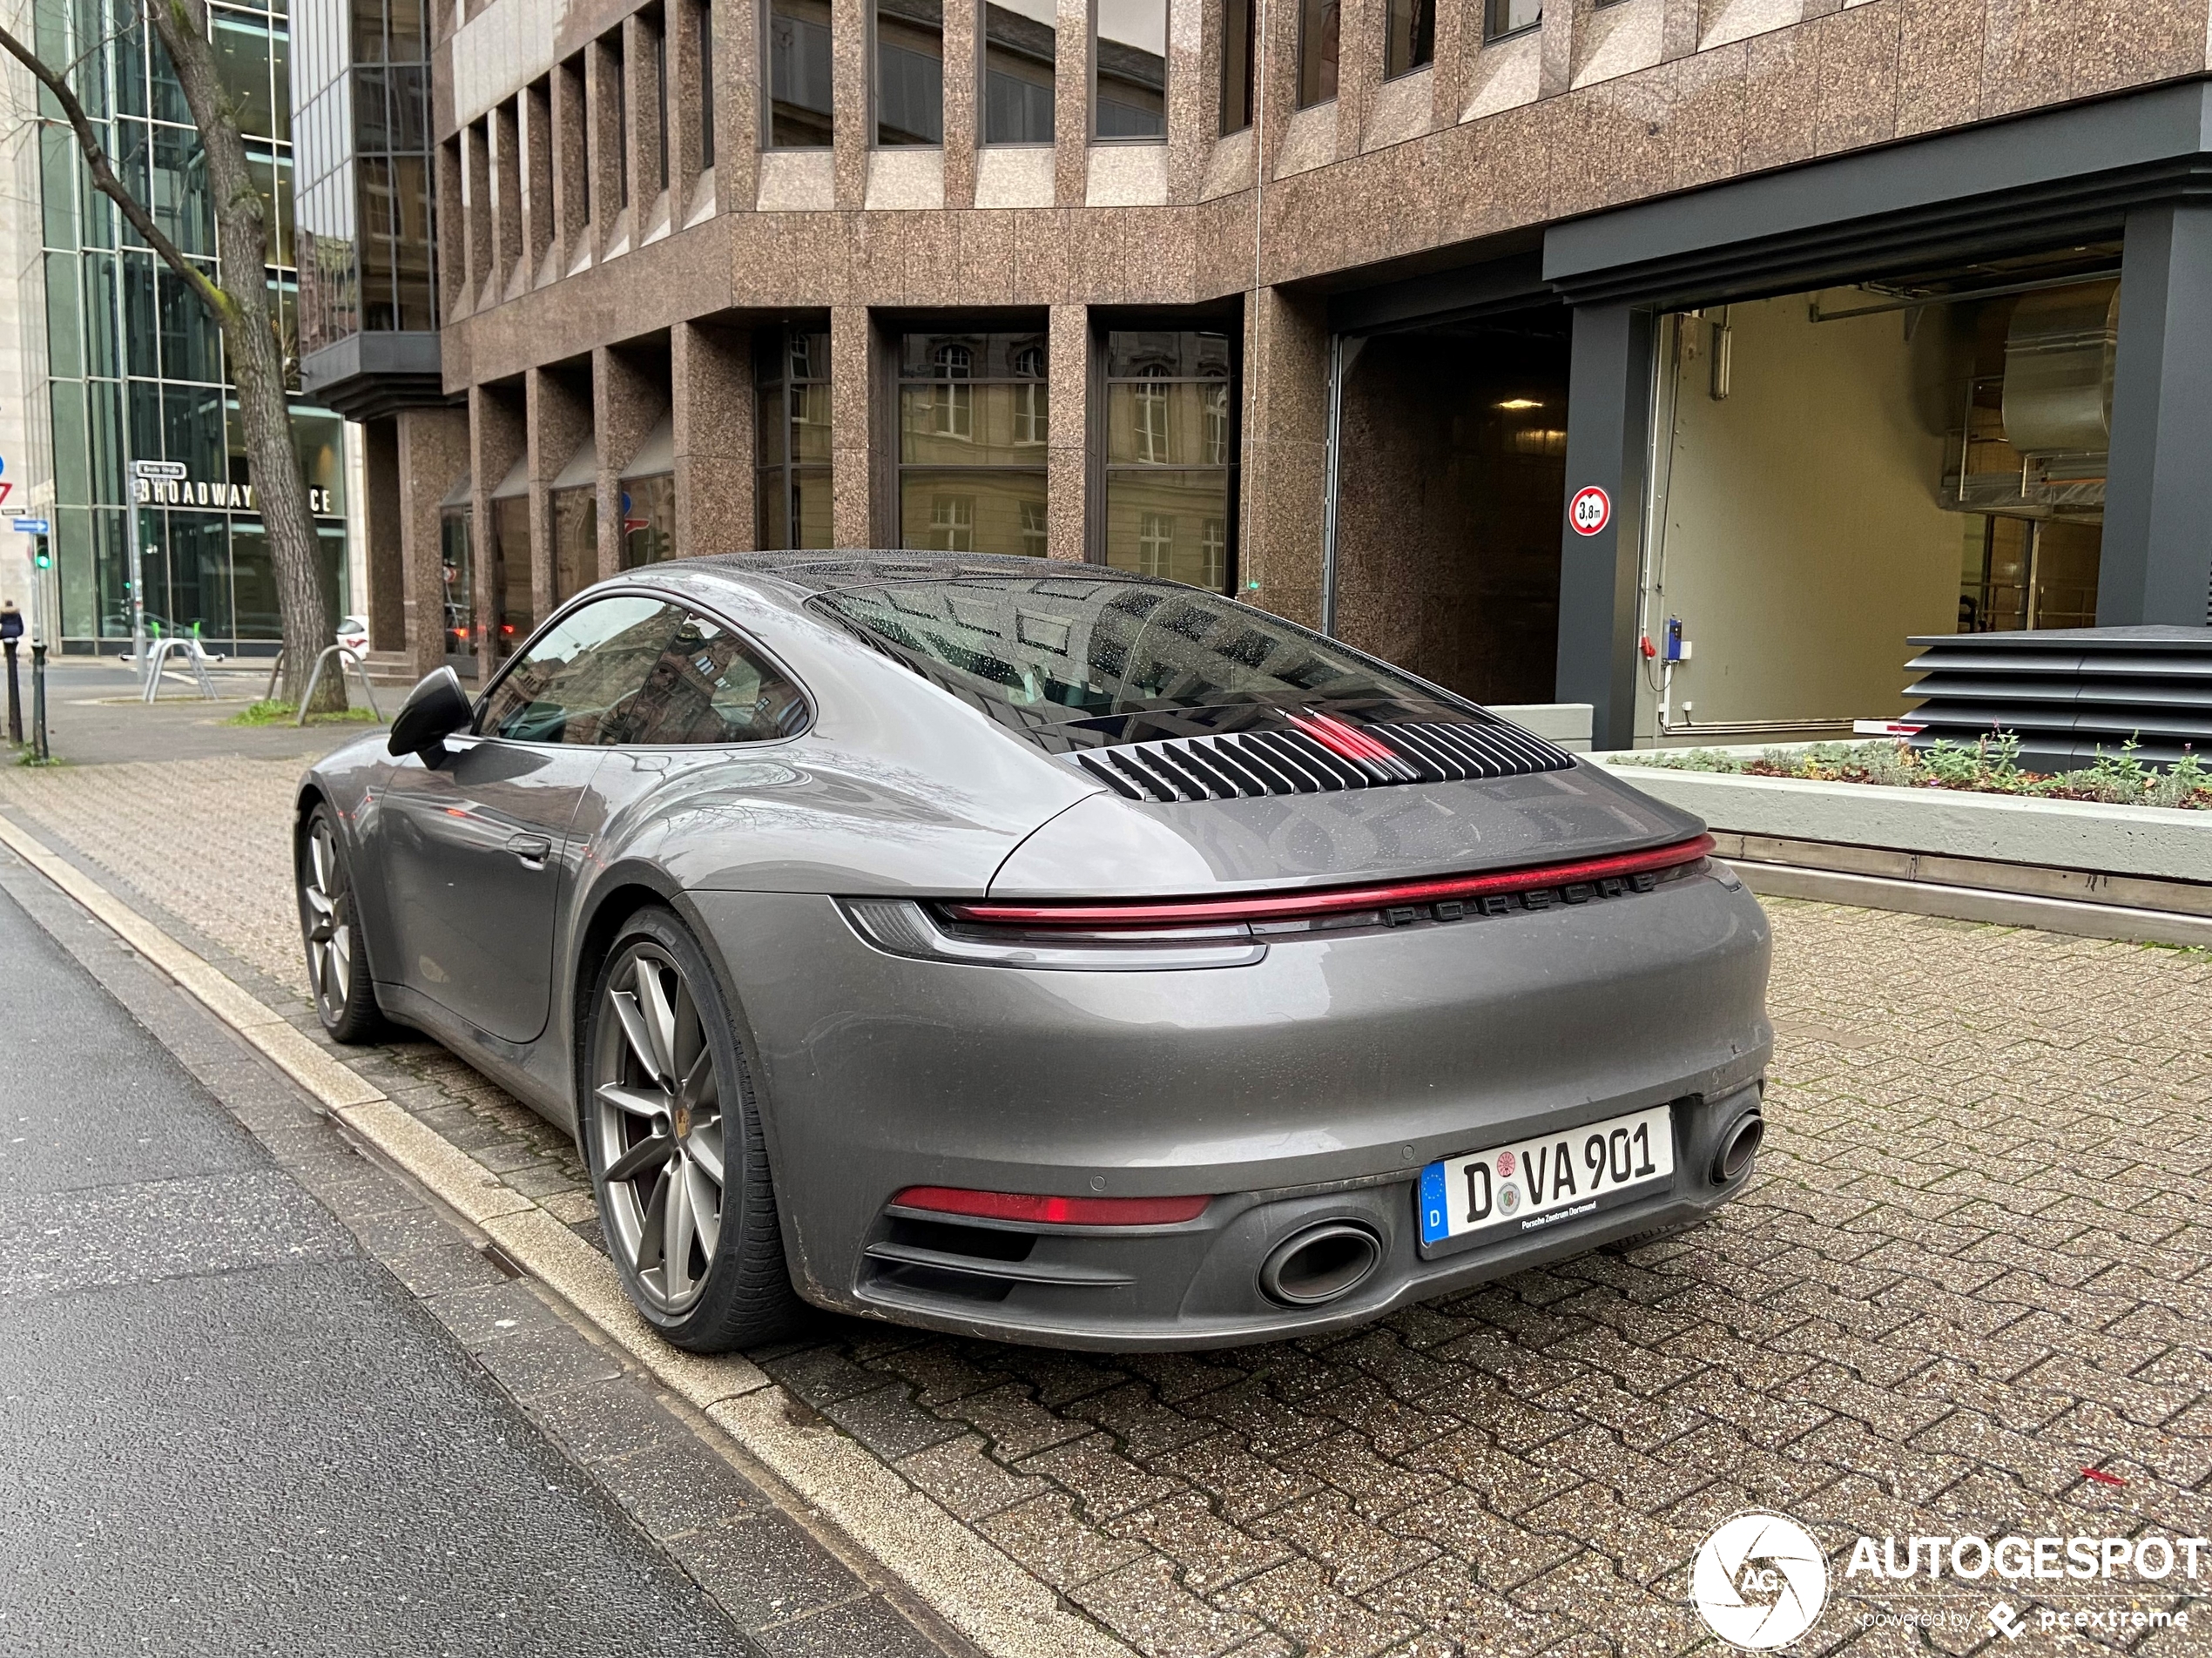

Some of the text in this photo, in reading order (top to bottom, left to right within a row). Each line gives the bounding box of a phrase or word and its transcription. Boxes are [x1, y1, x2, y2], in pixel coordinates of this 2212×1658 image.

[138, 478, 252, 507] BROADWAY
[1386, 873, 1654, 927] PORSCHE
[1463, 1161, 1493, 1223] D
[1521, 1142, 1577, 1205] VA
[1584, 1122, 1656, 1190] 901
[1429, 1210, 1440, 1227] D
[1521, 1200, 1597, 1230] Porsche Zentrum Dortmund
